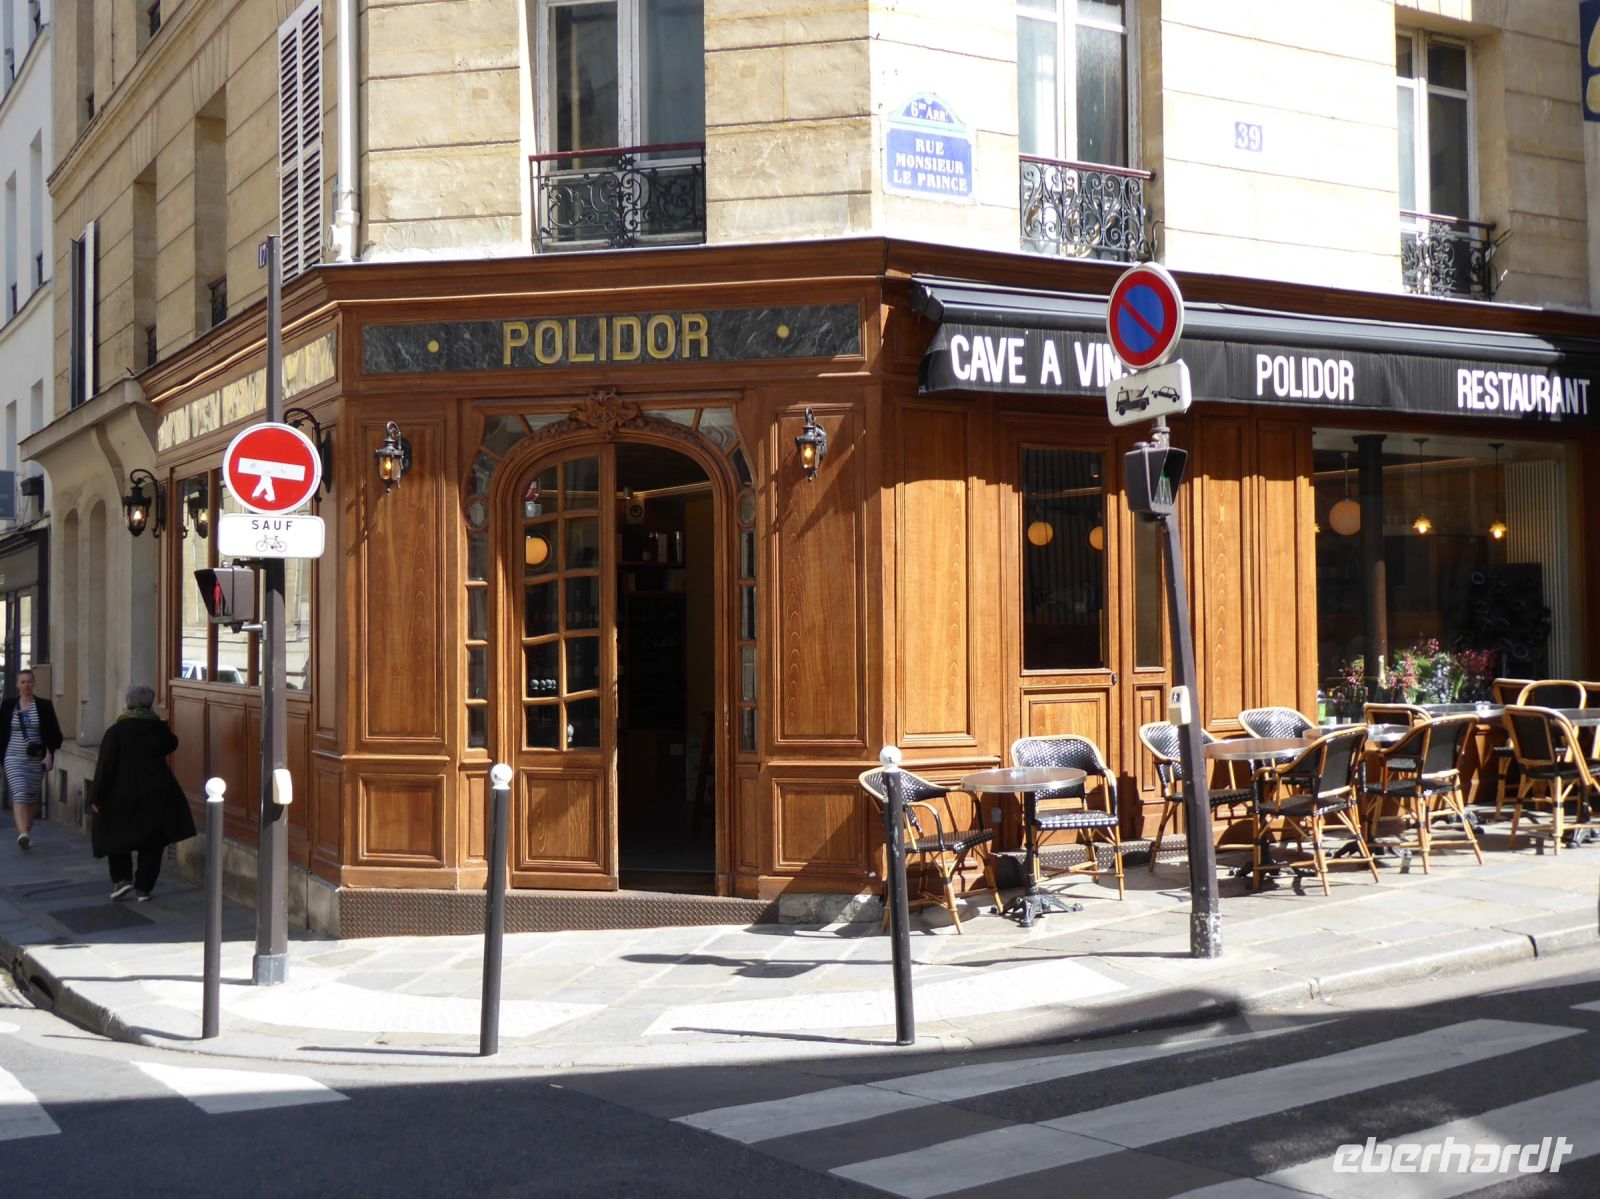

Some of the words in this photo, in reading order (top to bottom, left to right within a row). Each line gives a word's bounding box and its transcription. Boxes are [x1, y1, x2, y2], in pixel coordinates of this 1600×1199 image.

[915, 139, 944, 155] RUE
[1237, 123, 1260, 151] 39
[895, 153, 964, 174] MONSIEUR
[893, 169, 912, 185] LE
[917, 172, 967, 192] PRINCE
[503, 313, 709, 365] POLIDOR
[950, 335, 1026, 384] CAVE
[1040, 340, 1063, 386] A
[1074, 342, 1138, 388] VIN
[1256, 354, 1355, 401] POLIDOR
[1457, 369, 1590, 415] RESTAURANT
[252, 520, 293, 531] SAUF
